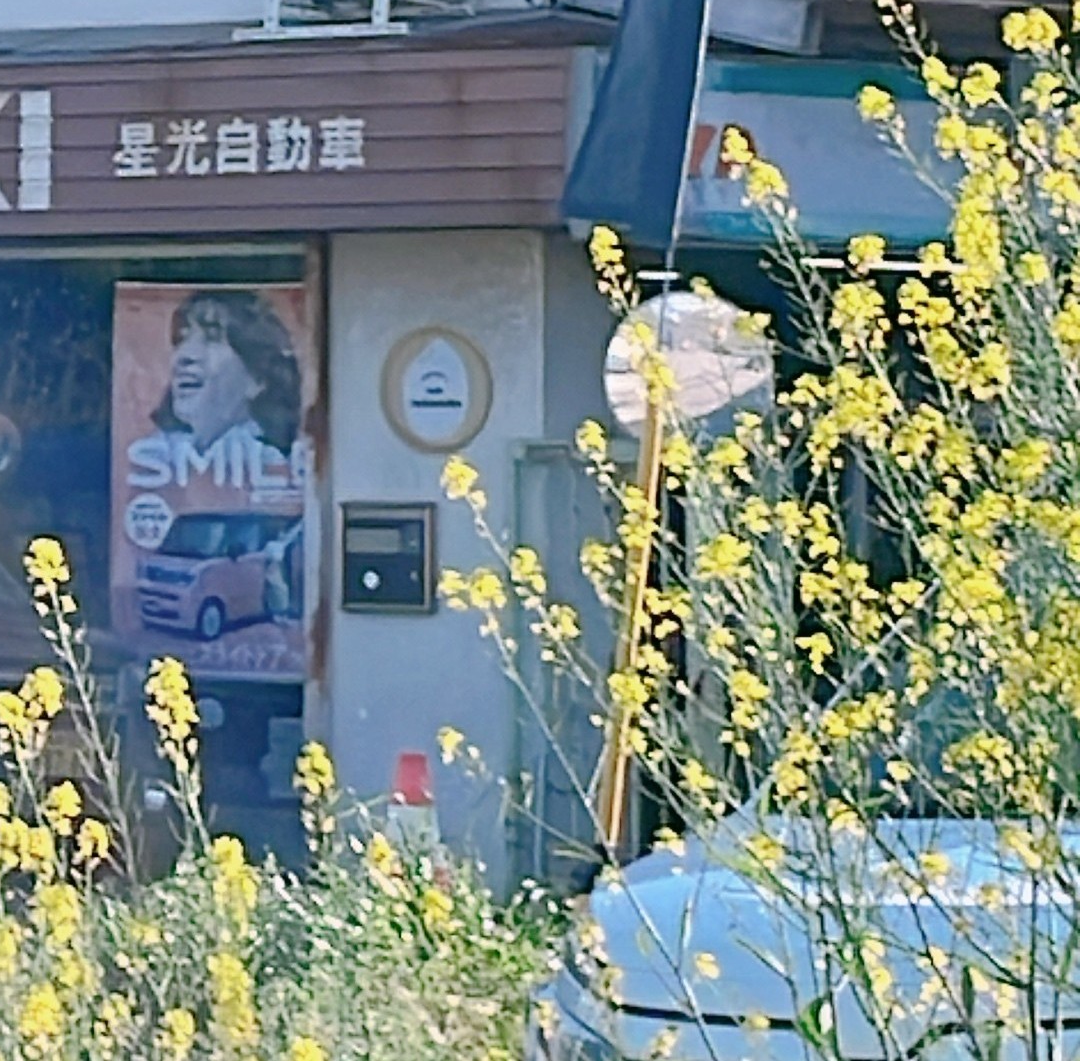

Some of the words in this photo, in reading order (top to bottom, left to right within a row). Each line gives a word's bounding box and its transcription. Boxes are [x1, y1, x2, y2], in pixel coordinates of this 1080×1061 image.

[113, 115, 366, 178] 星光自動車
